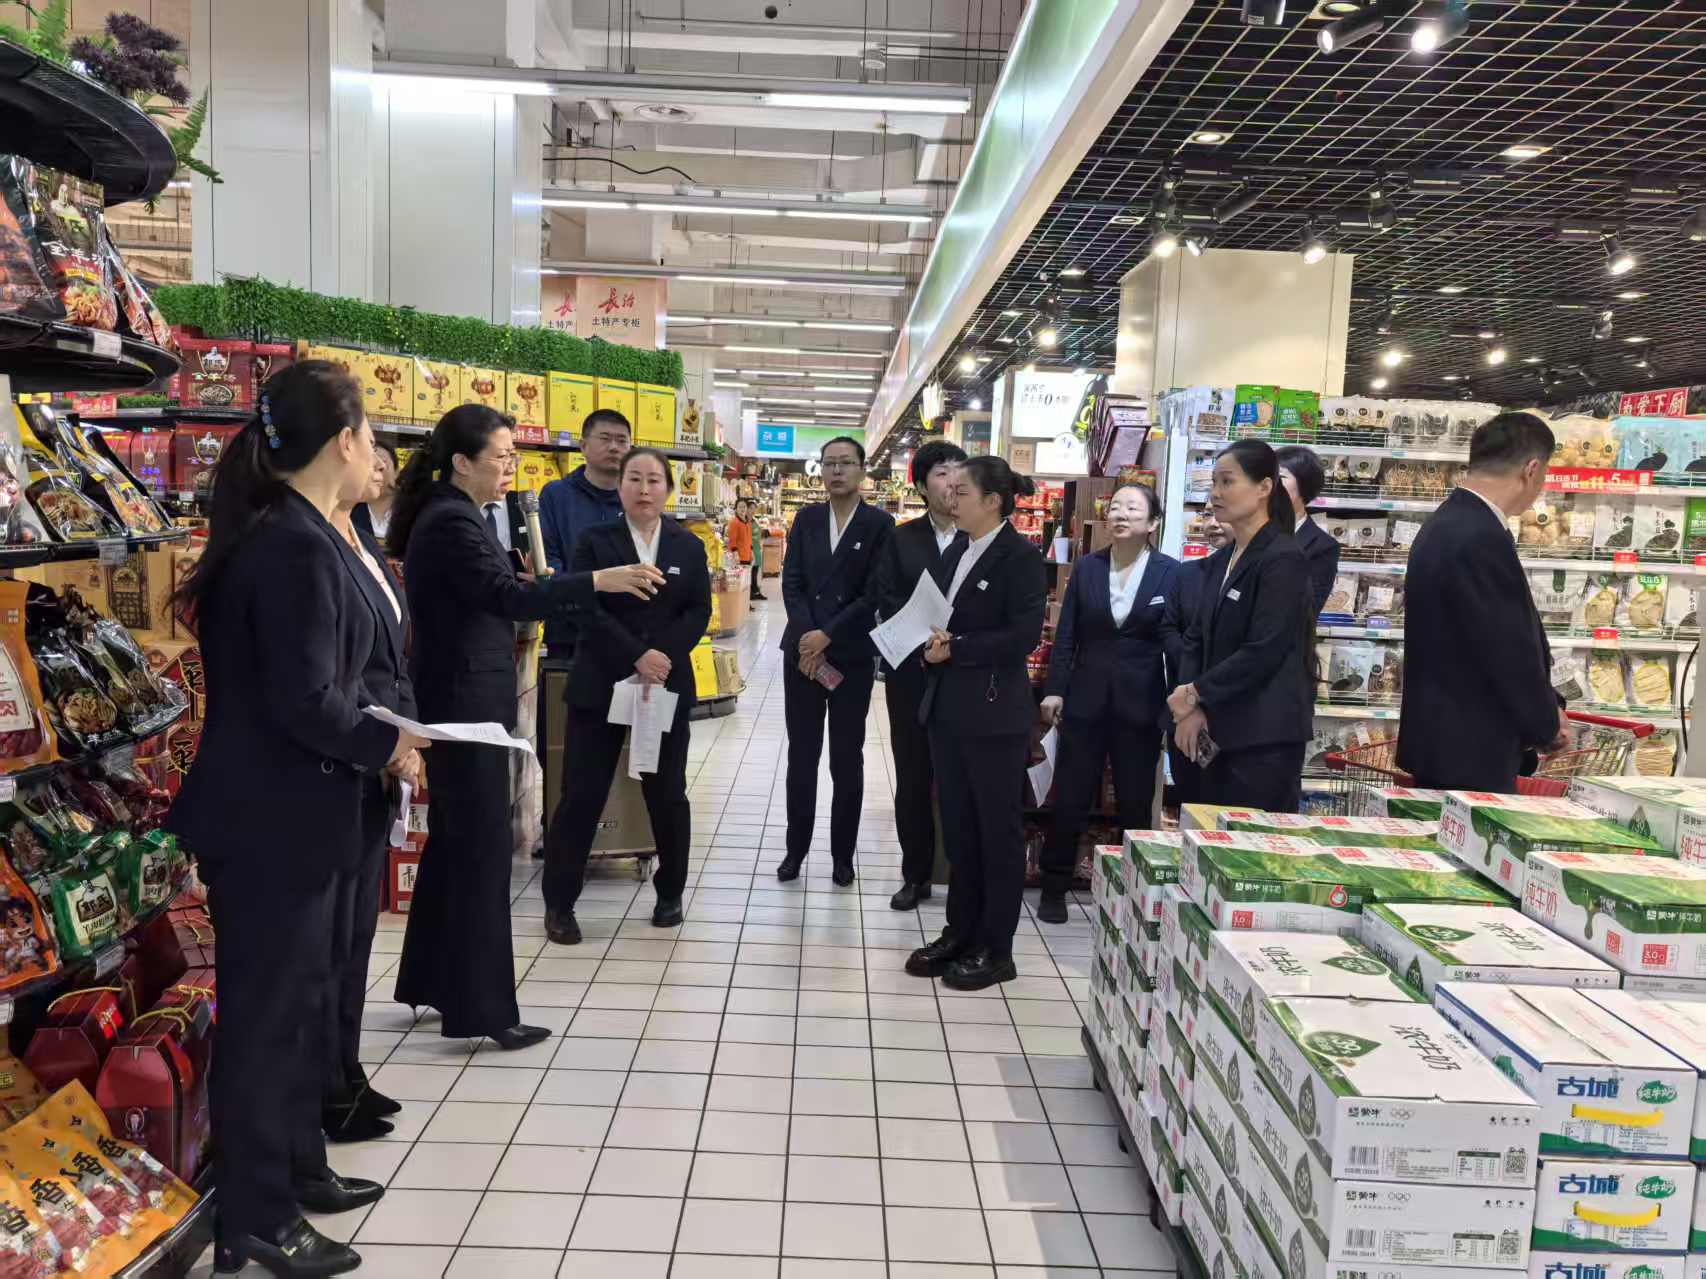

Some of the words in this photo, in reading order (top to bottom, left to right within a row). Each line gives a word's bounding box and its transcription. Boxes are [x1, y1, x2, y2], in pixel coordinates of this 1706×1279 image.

[591, 316, 640, 328] 土特产专柜
